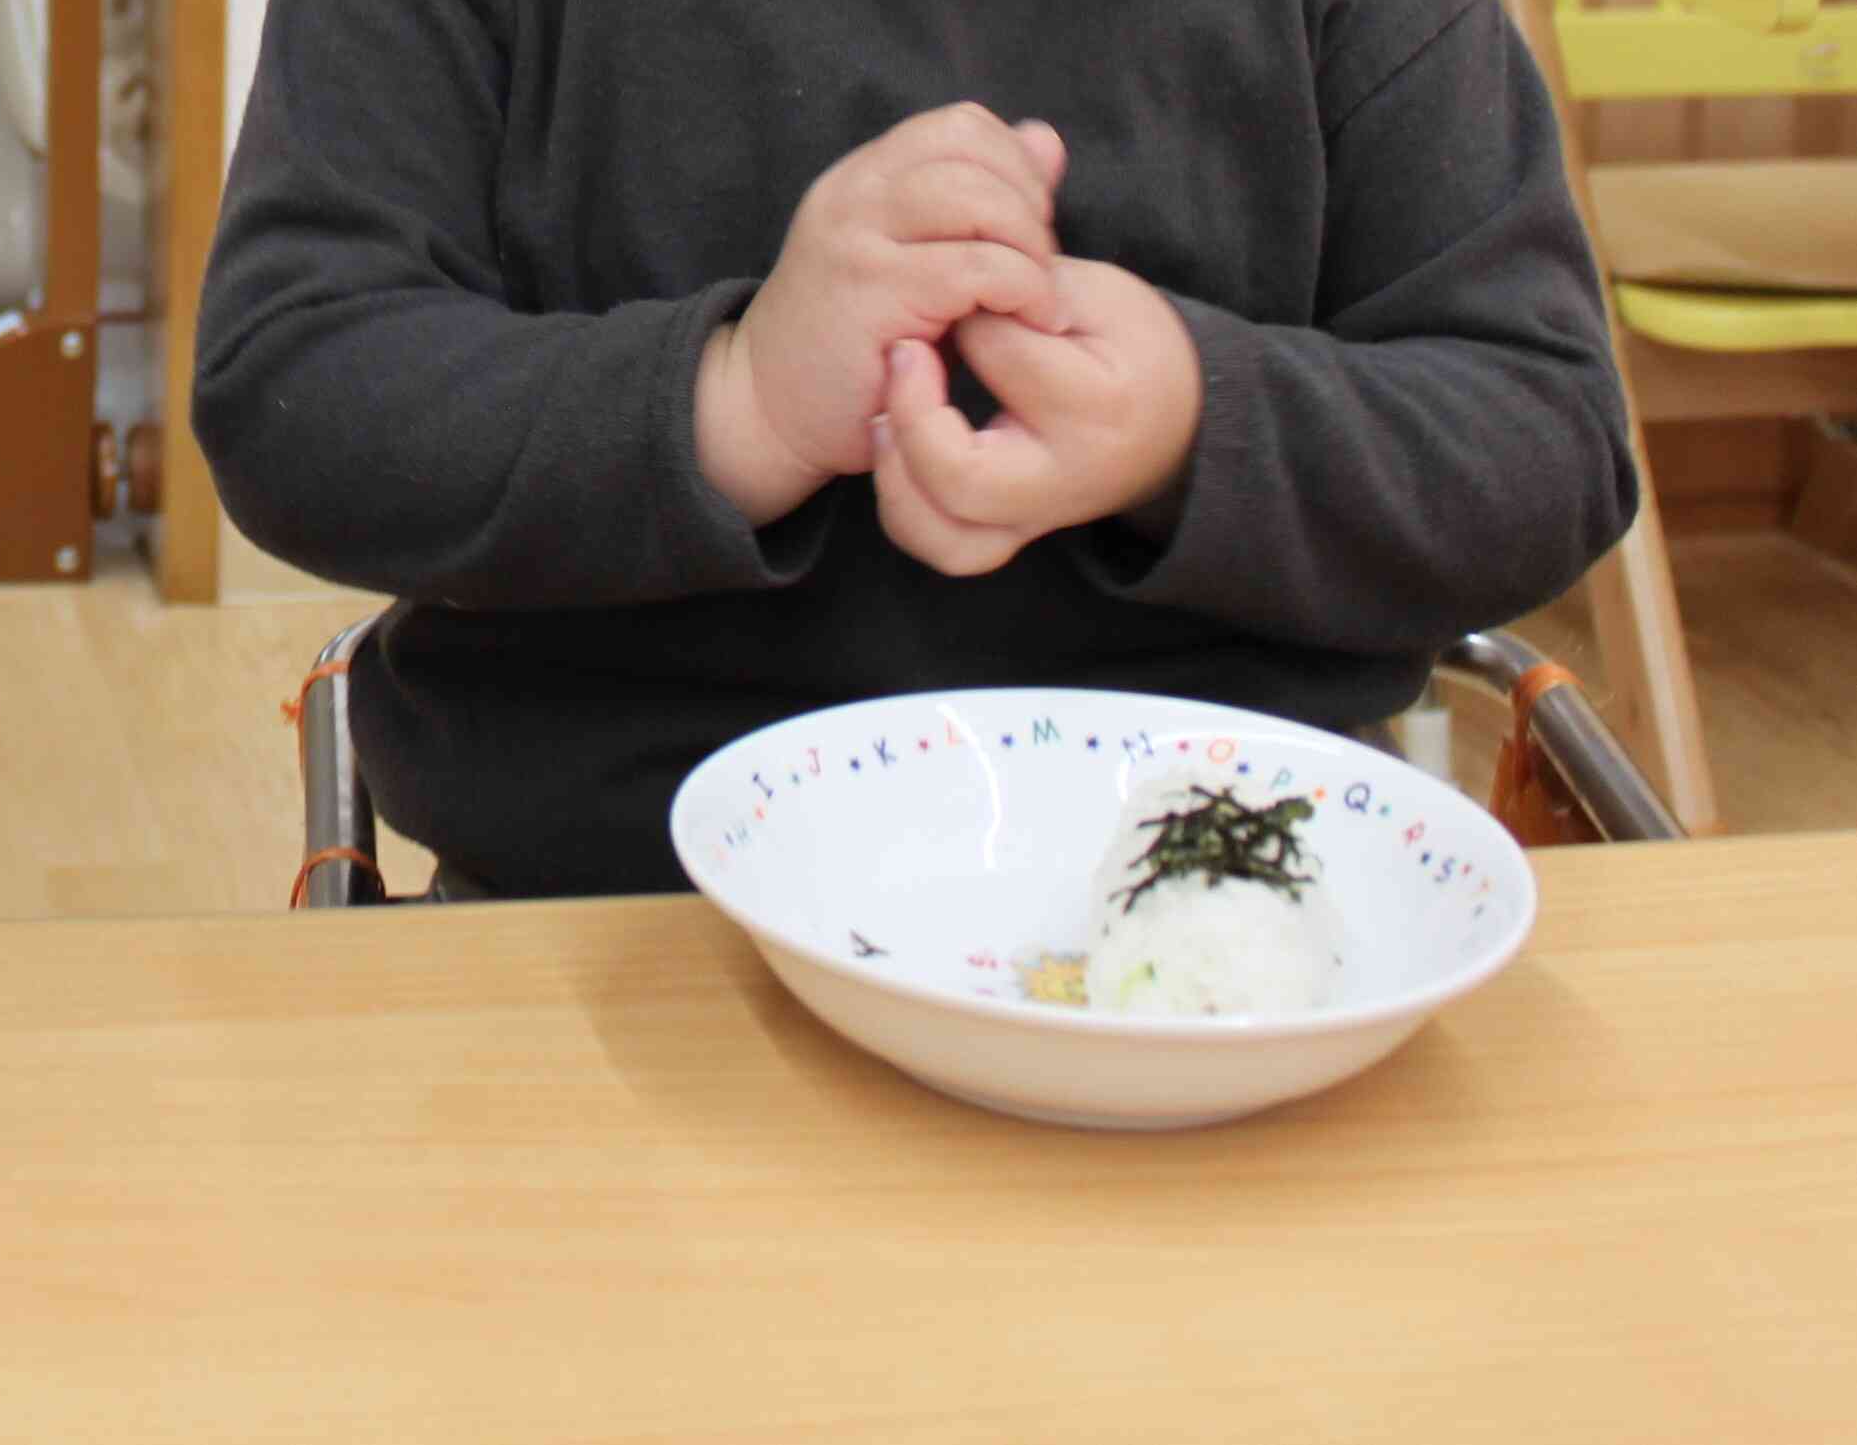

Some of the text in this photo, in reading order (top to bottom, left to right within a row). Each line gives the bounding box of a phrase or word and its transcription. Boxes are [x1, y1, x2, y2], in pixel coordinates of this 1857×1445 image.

[806, 747, 822, 776] J
[871, 736, 898, 768] K
[1033, 717, 1062, 746] M
[1207, 737, 1236, 765] O
[1269, 767, 1294, 791] P
[1344, 782, 1371, 815] Q
